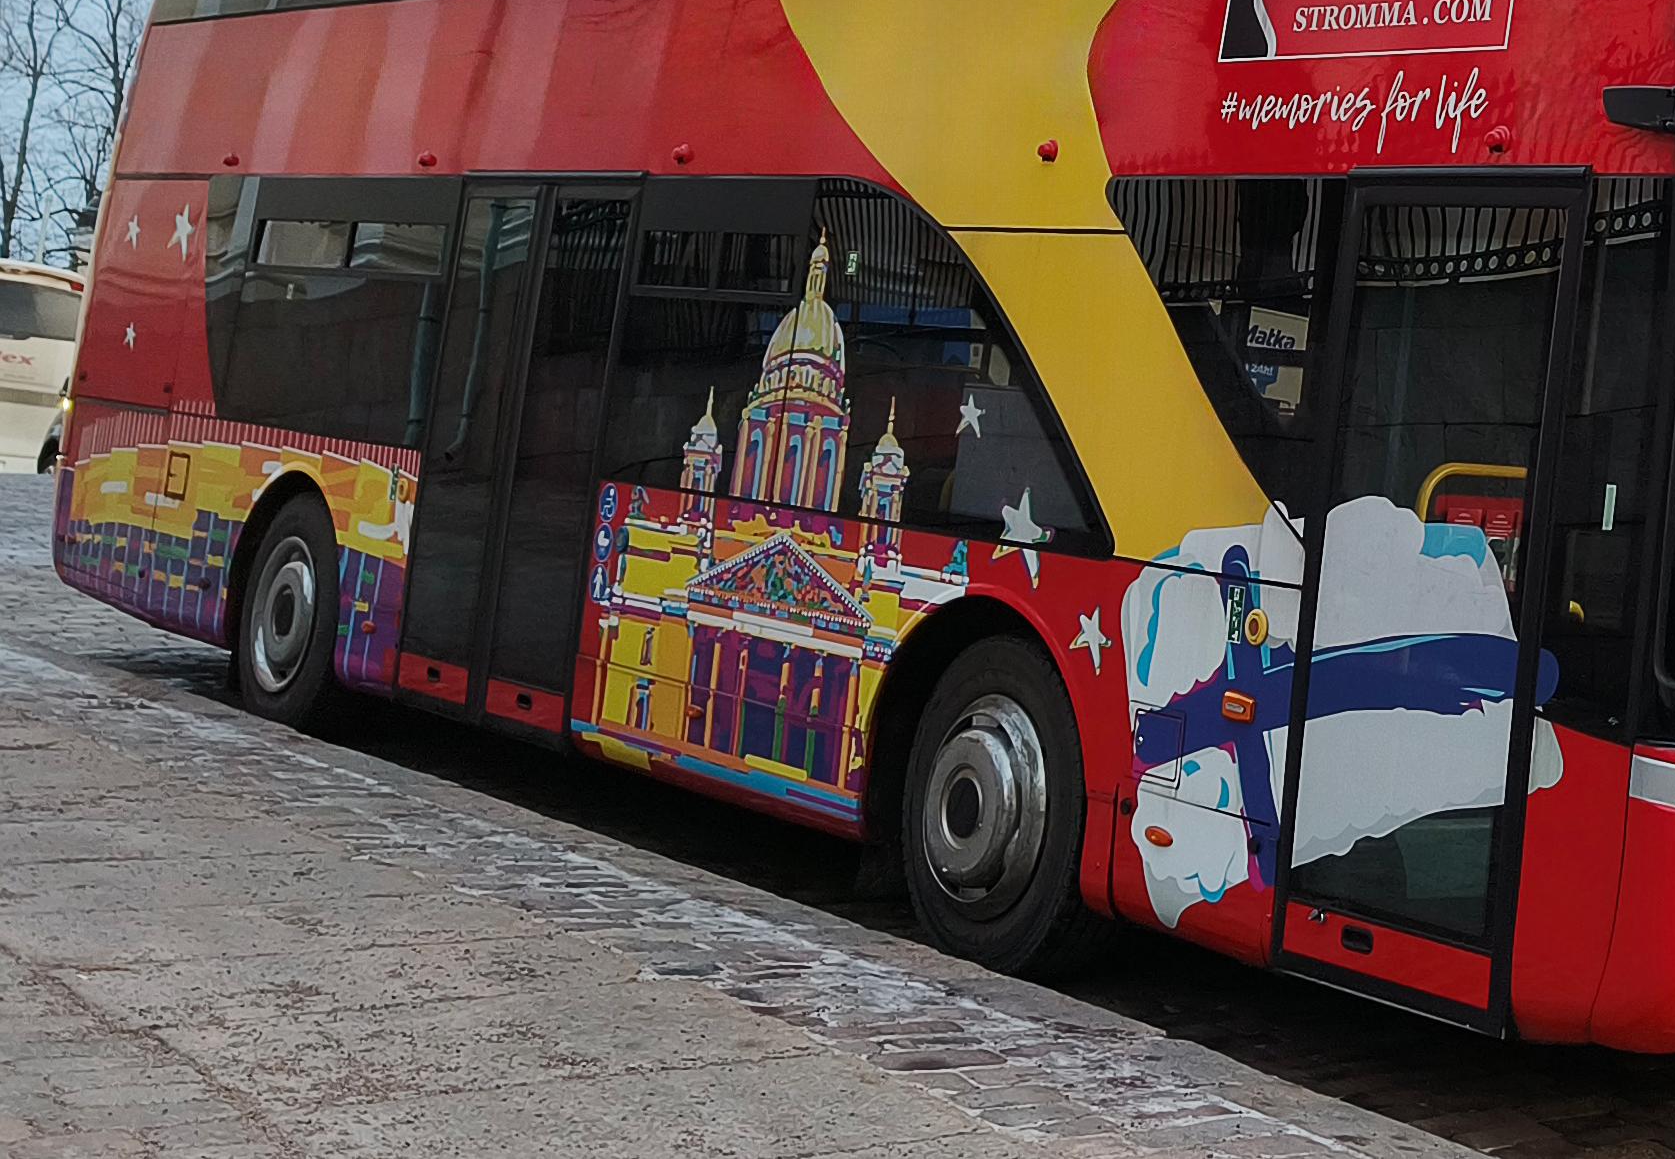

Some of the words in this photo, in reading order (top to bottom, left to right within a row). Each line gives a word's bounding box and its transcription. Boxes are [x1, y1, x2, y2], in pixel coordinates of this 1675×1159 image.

[1220, 85, 1377, 132] #memories
[1375, 70, 1432, 154] for
[1435, 67, 1490, 154] life
